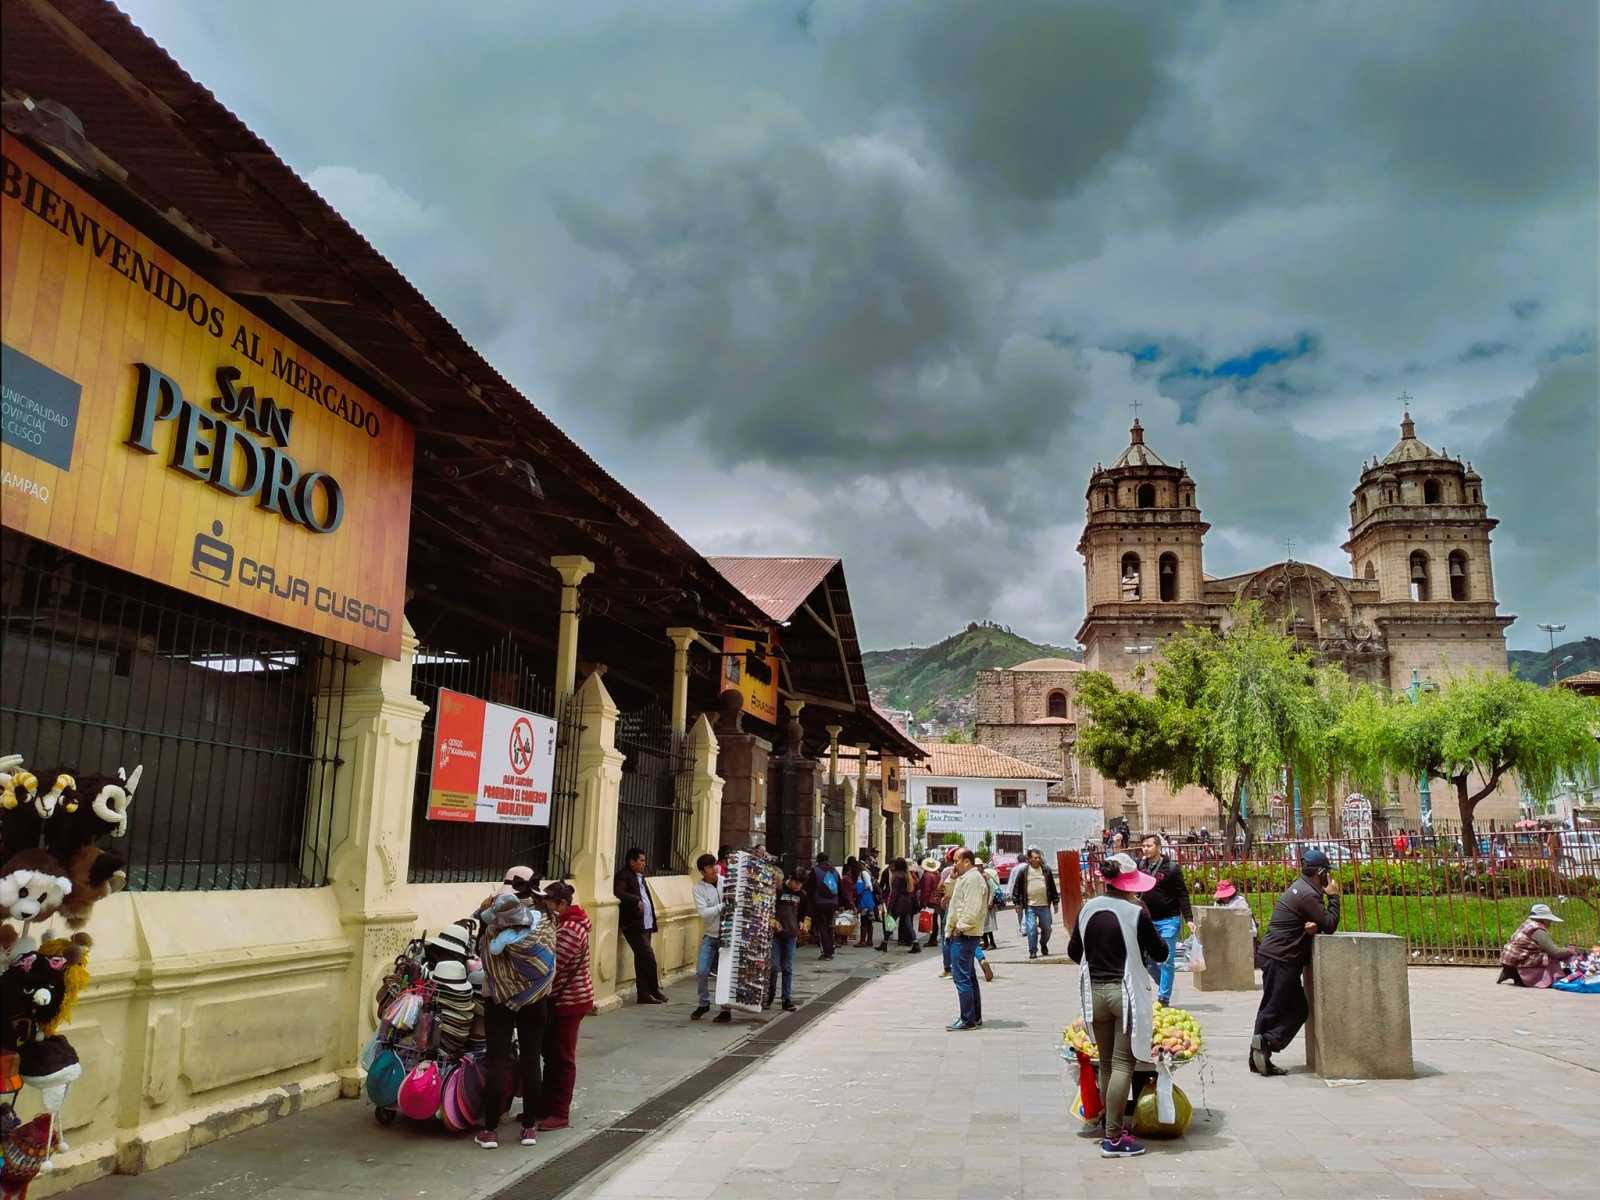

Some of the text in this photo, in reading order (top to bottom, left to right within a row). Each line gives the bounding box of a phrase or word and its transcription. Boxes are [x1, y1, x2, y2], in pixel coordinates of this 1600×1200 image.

[1, 155, 381, 438] BIENVENIDOS AL MERCADO
[8, 421, 42, 446] CUSCO
[211, 366, 294, 448] SAN
[1, 469, 49, 504] AMPAQ
[122, 362, 345, 534] PEDRO
[238, 557, 391, 633] CAJA CUSCO
